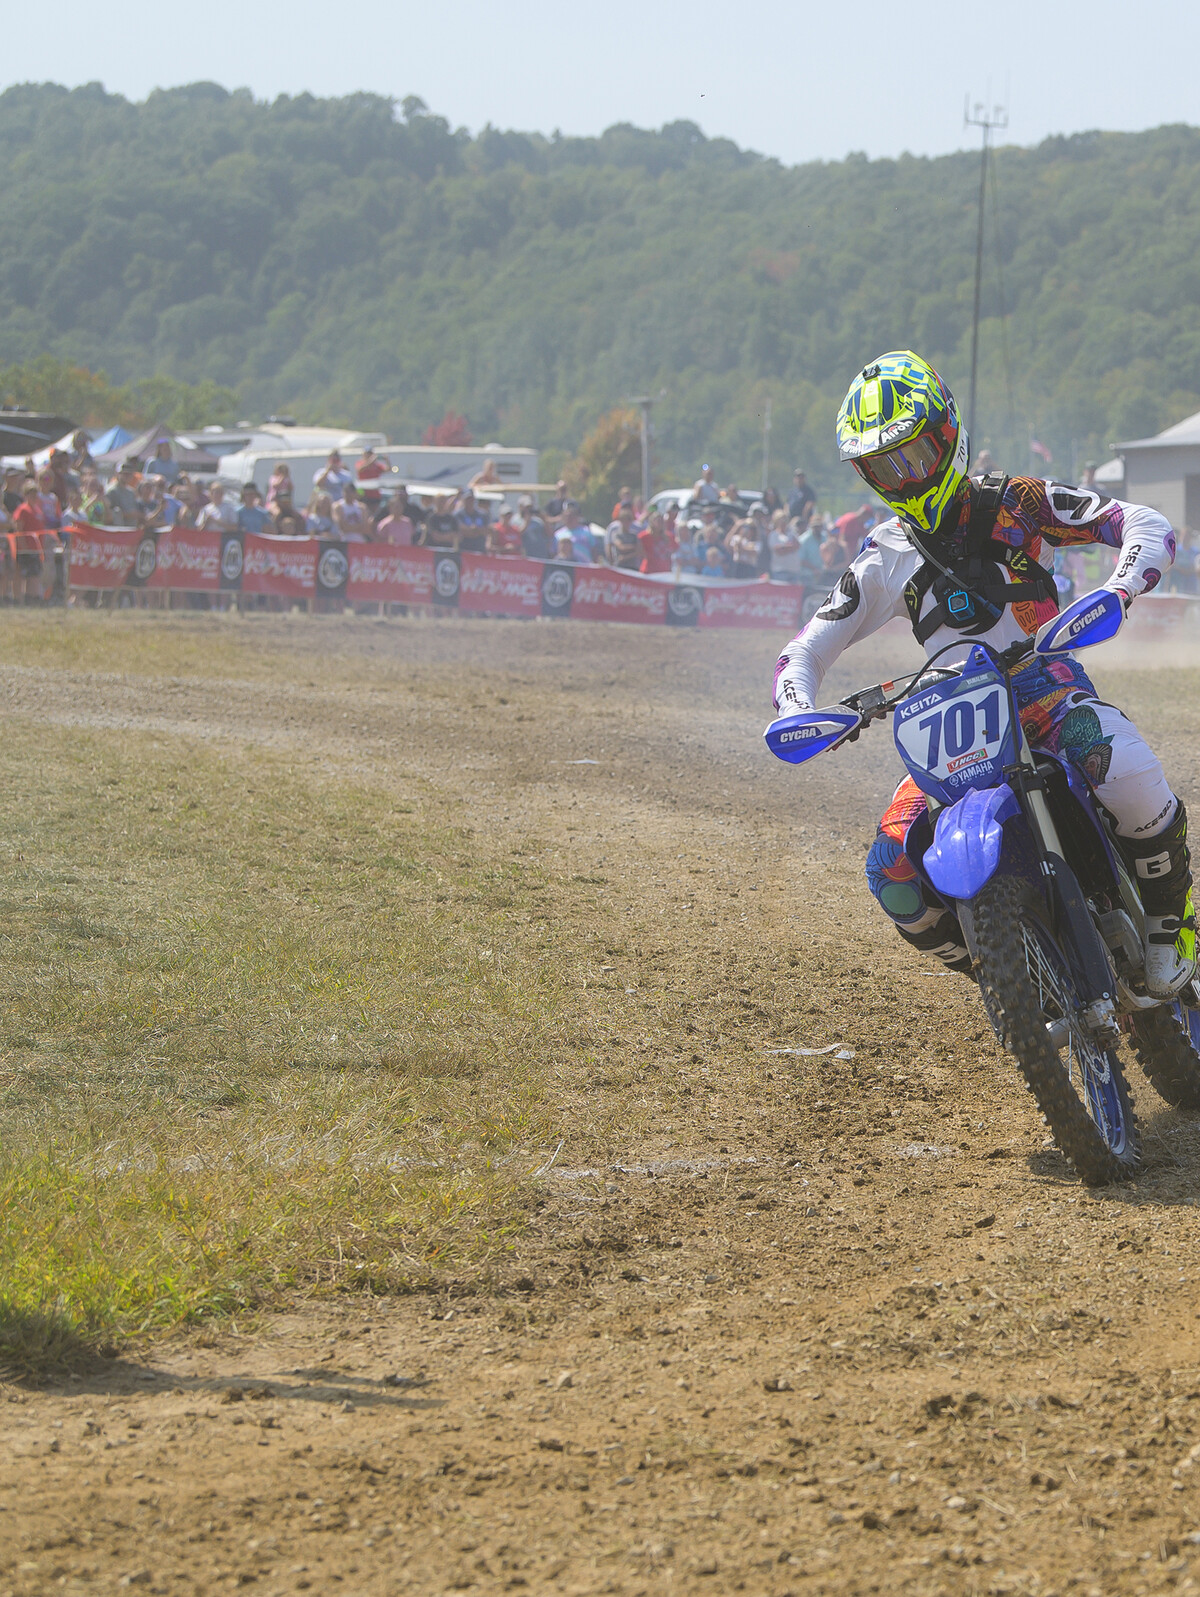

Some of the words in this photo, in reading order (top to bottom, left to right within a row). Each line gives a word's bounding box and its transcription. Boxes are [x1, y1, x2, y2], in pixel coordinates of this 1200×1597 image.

[1072, 604, 1107, 634] CYCRA
[900, 692, 943, 719] KEITA
[780, 727, 817, 744] CYCRA
[918, 689, 1000, 771] 701
[957, 760, 995, 782] YAMAHA
